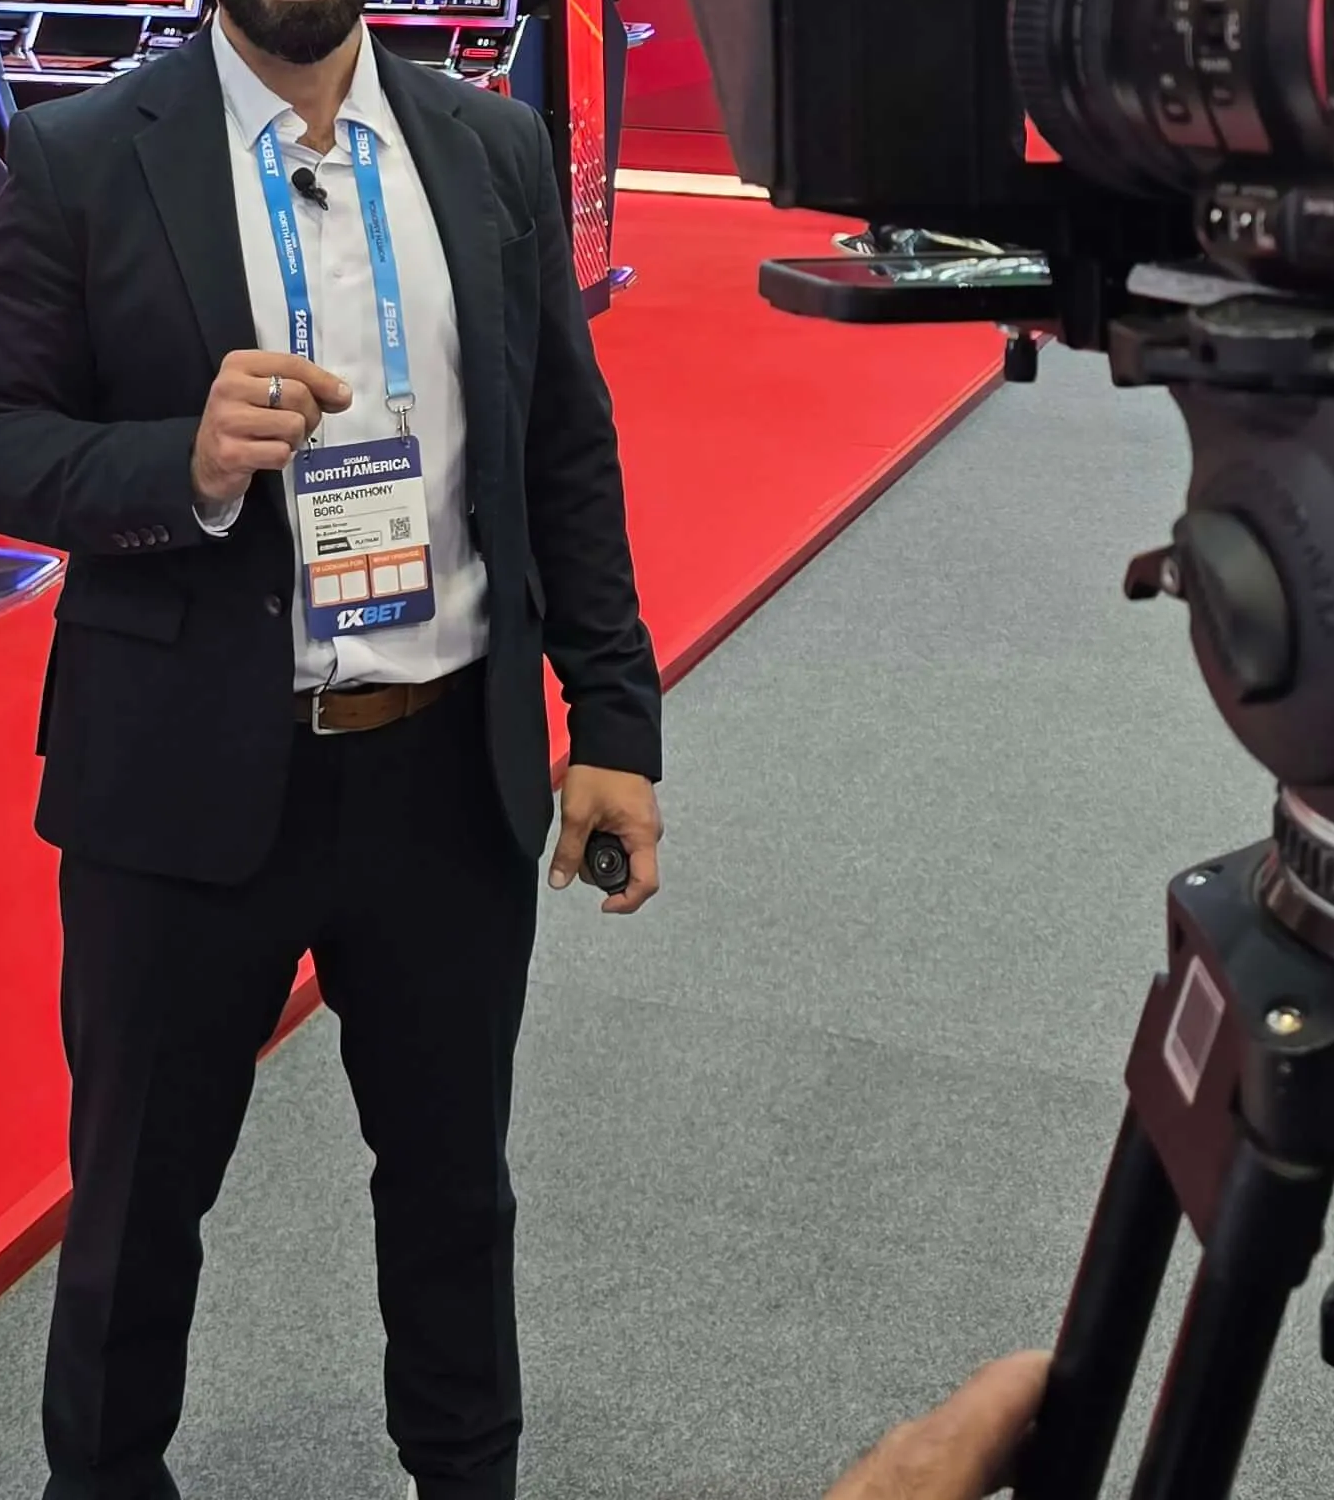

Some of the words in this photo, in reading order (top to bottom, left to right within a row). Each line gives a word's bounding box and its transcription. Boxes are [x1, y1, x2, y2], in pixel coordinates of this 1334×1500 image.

[260, 133, 280, 177] 1XBET
[384, 298, 400, 349] 1XBET
[304, 466, 352, 484] NORTH
[352, 457, 411, 477] AMERICA
[312, 492, 344, 506] MARK
[344, 485, 394, 501] ANTHONY
[313, 505, 344, 518] BORG
[337, 601, 407, 630] 1XBET
